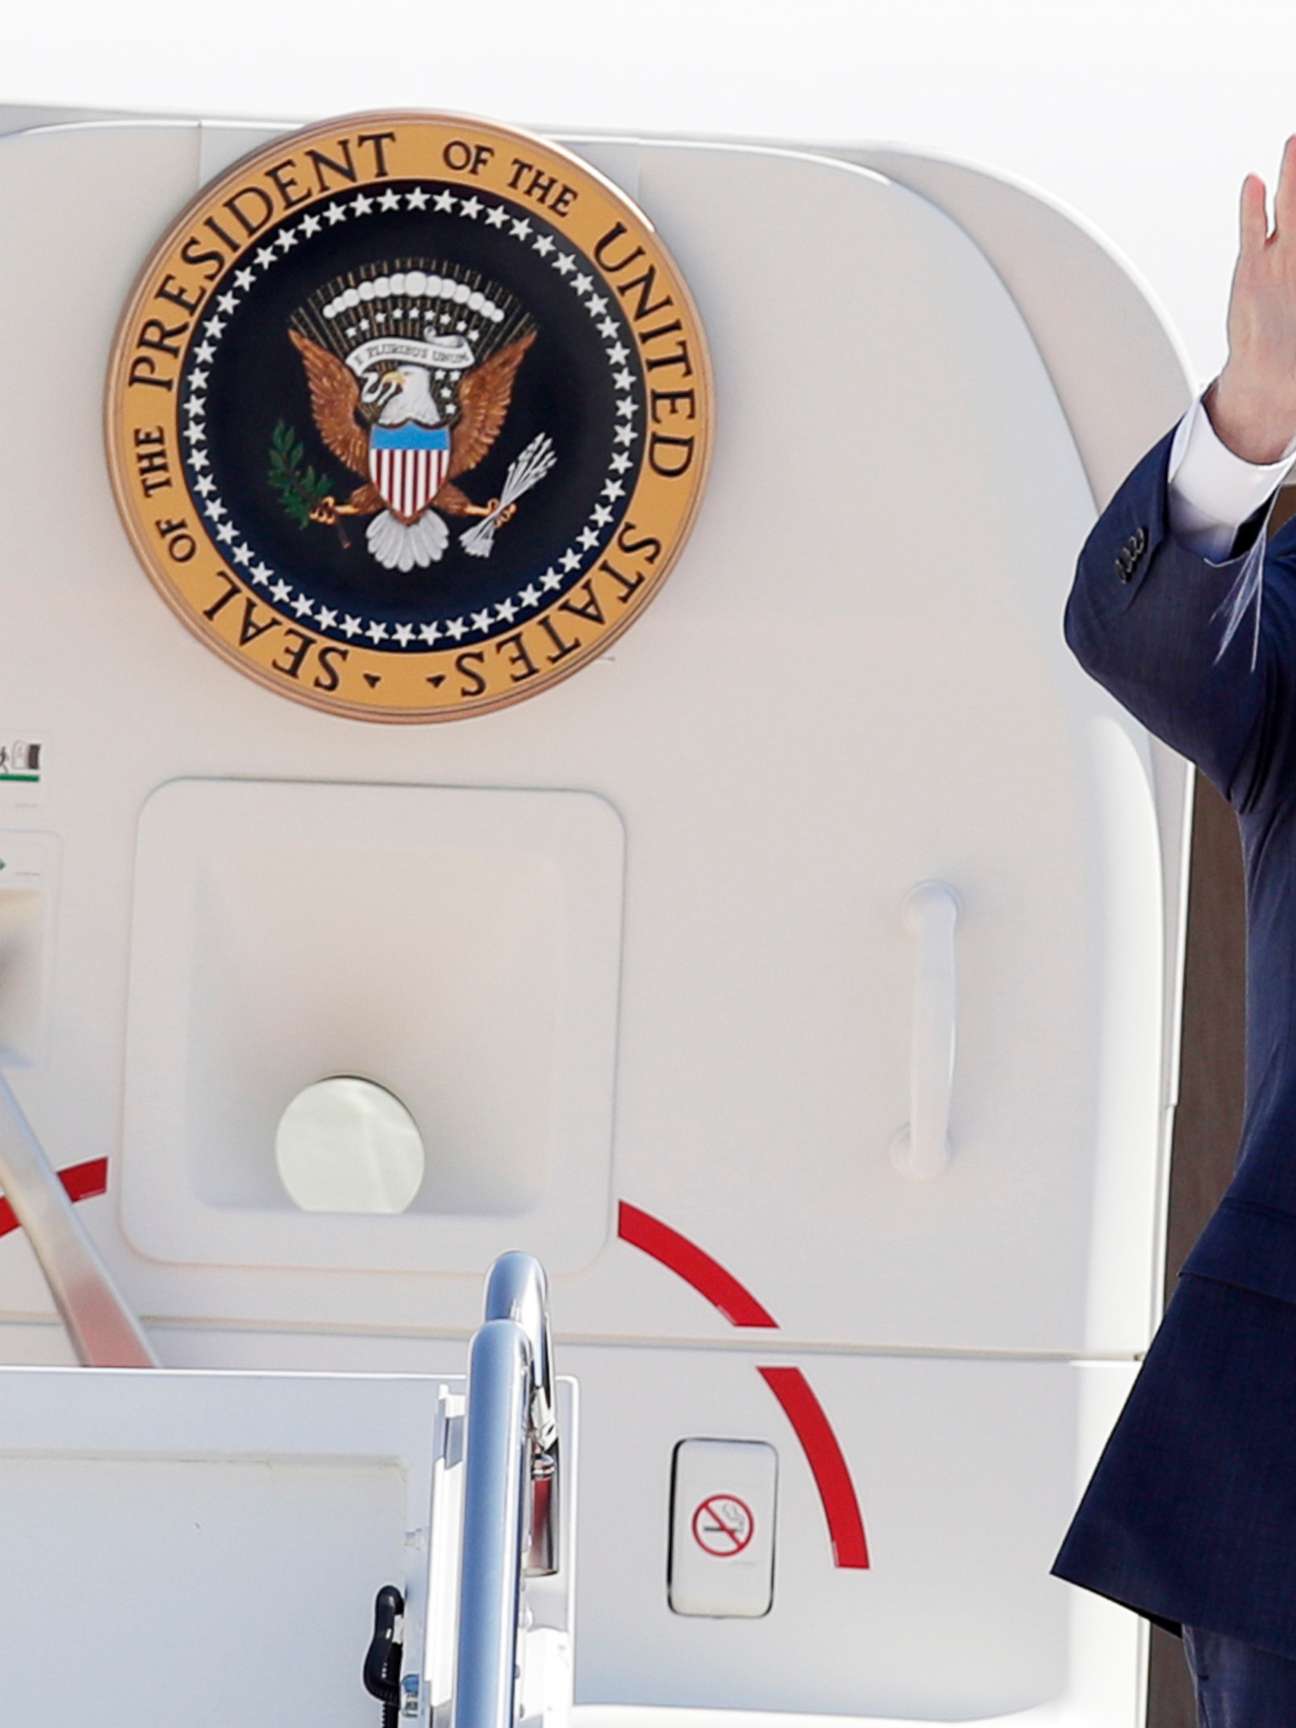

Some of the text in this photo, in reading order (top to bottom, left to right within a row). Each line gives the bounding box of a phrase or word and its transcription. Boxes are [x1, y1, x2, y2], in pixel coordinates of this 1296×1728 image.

[127, 131, 696, 697] SEAL OF THE PRESIDENT OF THE UNITED STATES
